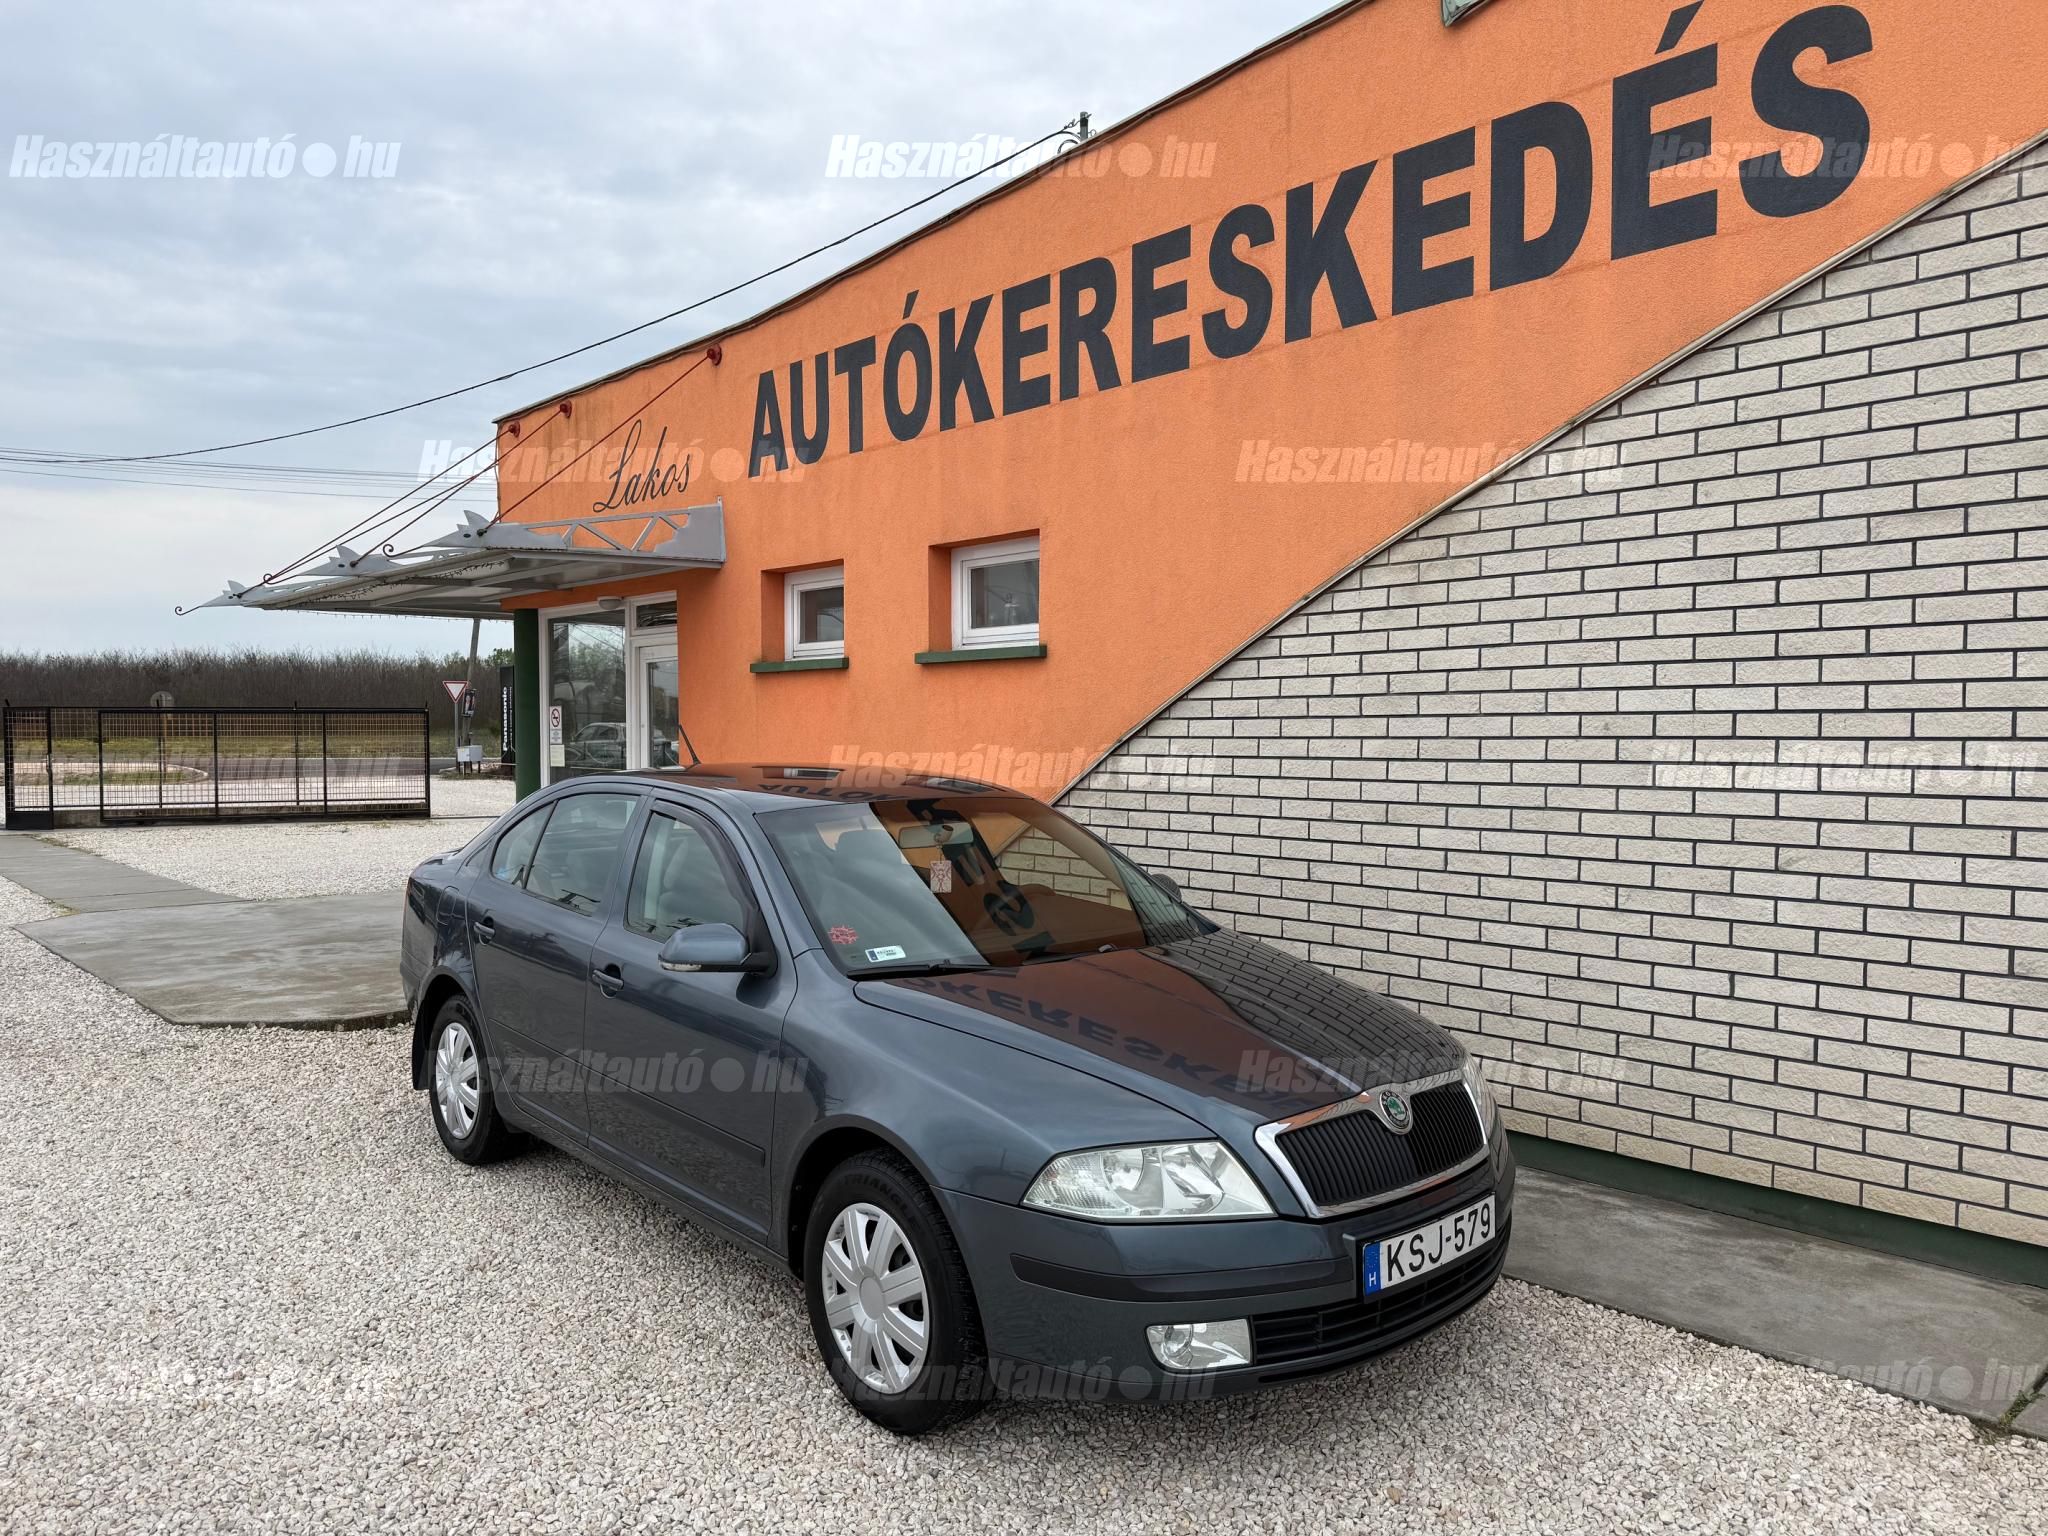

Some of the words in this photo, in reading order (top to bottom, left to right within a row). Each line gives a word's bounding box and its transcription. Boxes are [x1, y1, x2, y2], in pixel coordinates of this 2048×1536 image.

[748, 2, 1873, 478] AUTÓKERESKEDÉS
[592, 418, 691, 513] Lakos
[1387, 1202, 1491, 1282] KSJ-579
